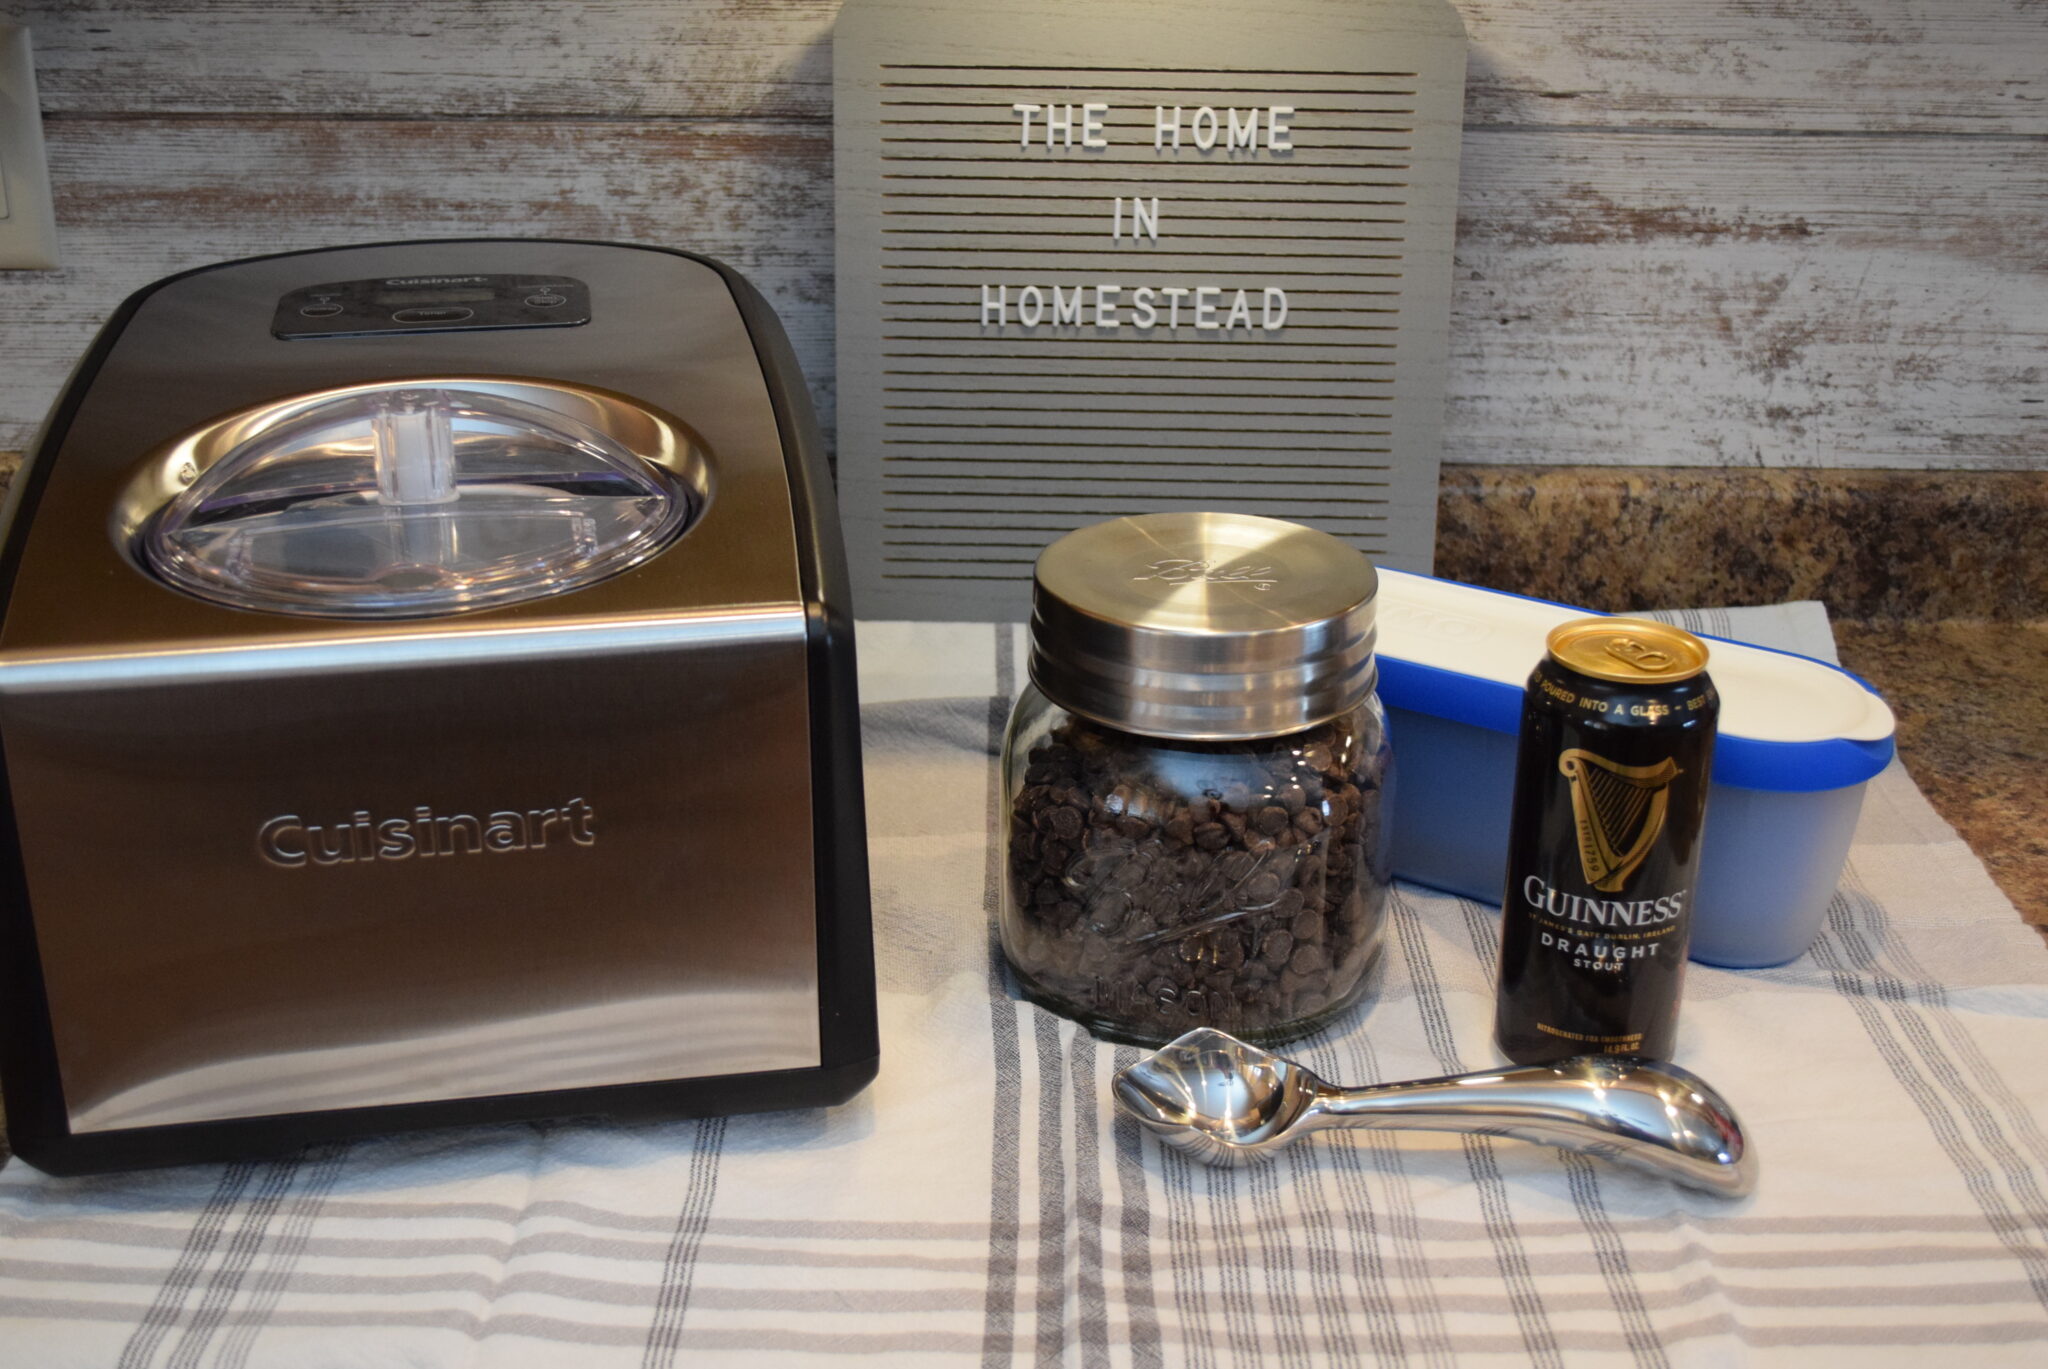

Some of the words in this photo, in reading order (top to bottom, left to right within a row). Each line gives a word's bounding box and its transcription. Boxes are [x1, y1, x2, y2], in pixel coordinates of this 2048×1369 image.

[1013, 103, 1108, 150] THE
[1154, 105, 1295, 155] HOME
[1112, 196, 1160, 241] IN
[385, 276, 486, 287] Cuisinart
[980, 284, 1289, 331] HOMESTEAD
[1539, 679, 1576, 703] POURED
[1579, 697, 1608, 713] INTO
[1614, 703, 1625, 716] A
[1630, 704, 1669, 717] GLASS
[258, 797, 595, 868] Cuisinart
[1583, 845, 1600, 872] 1759
[1523, 874, 1685, 927] GUINNESS
[1541, 931, 1660, 959] DRAUGHT
[1573, 957, 1624, 972] STOUT
